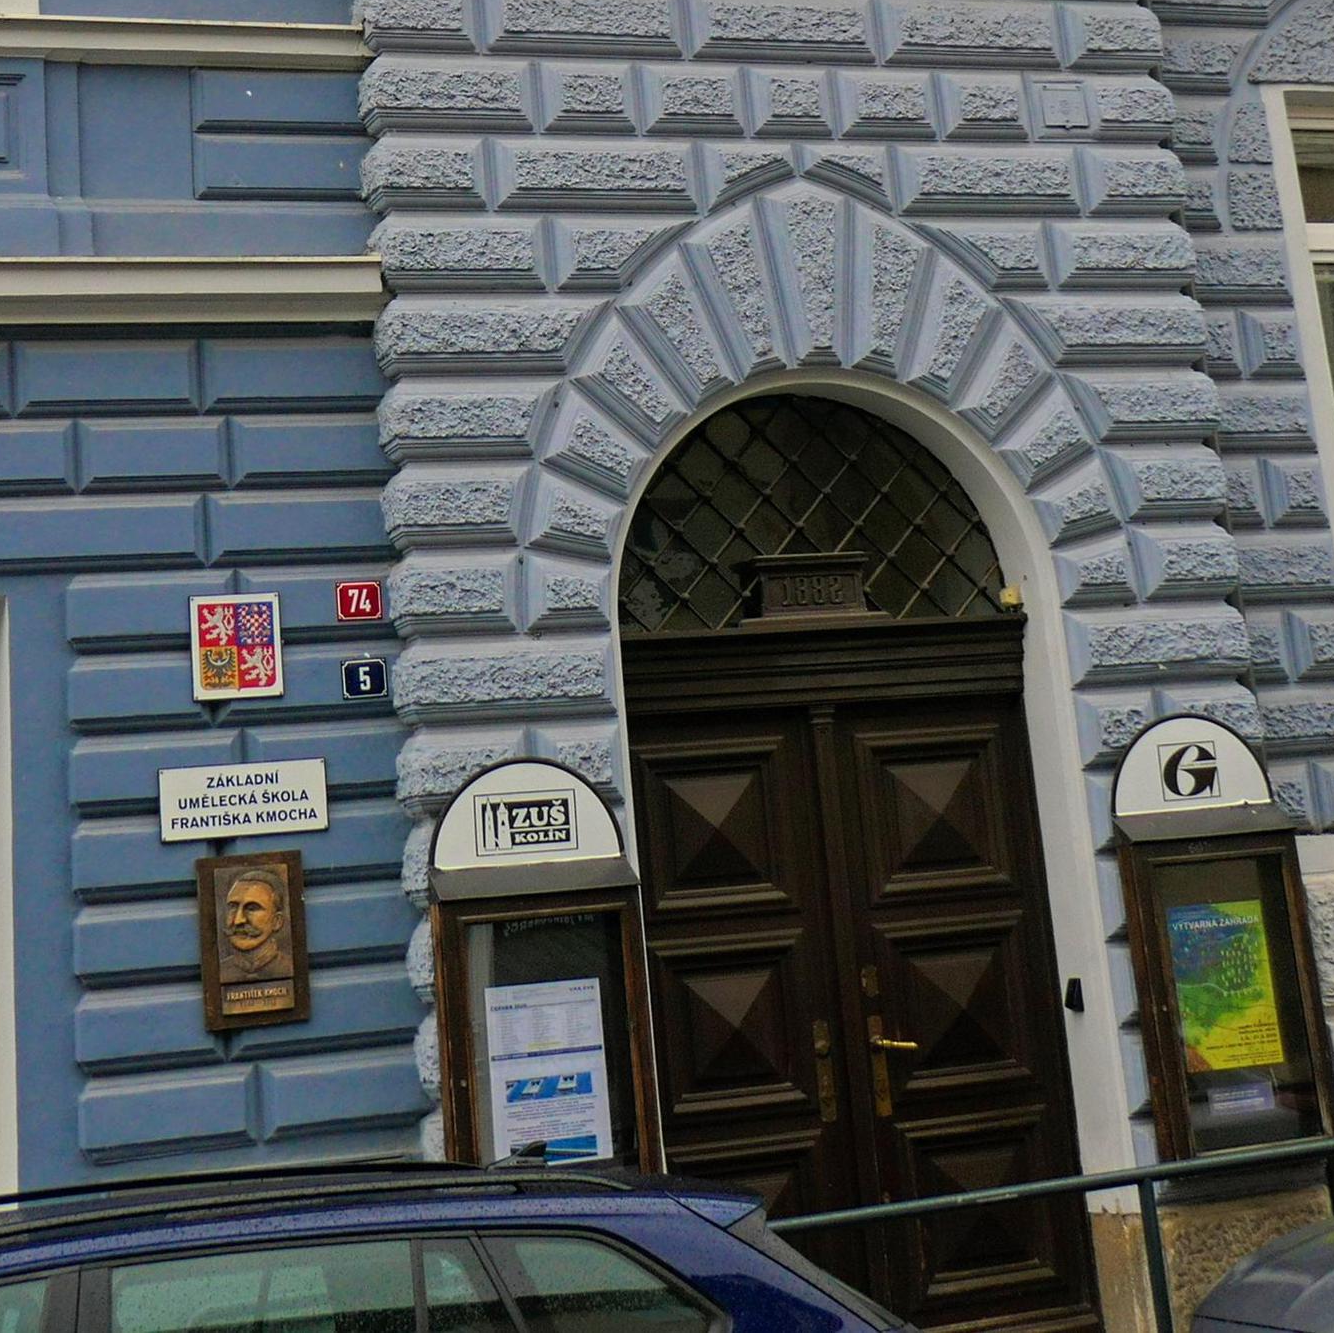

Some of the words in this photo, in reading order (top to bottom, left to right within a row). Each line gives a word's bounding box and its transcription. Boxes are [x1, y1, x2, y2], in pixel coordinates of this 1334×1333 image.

[348, 588, 372, 613] 74
[359, 666, 371, 691] 5
[206, 770, 279, 789] ZÁKLADNÍ
[178, 790, 257, 810] UMĚLECKÁ
[262, 789, 309, 804] ŠKOLA
[171, 812, 251, 830] FRANTIŠKA
[256, 807, 318, 823] KMOCHA
[512, 799, 566, 828] ZUŠ
[514, 828, 567, 844] KOLÍN
